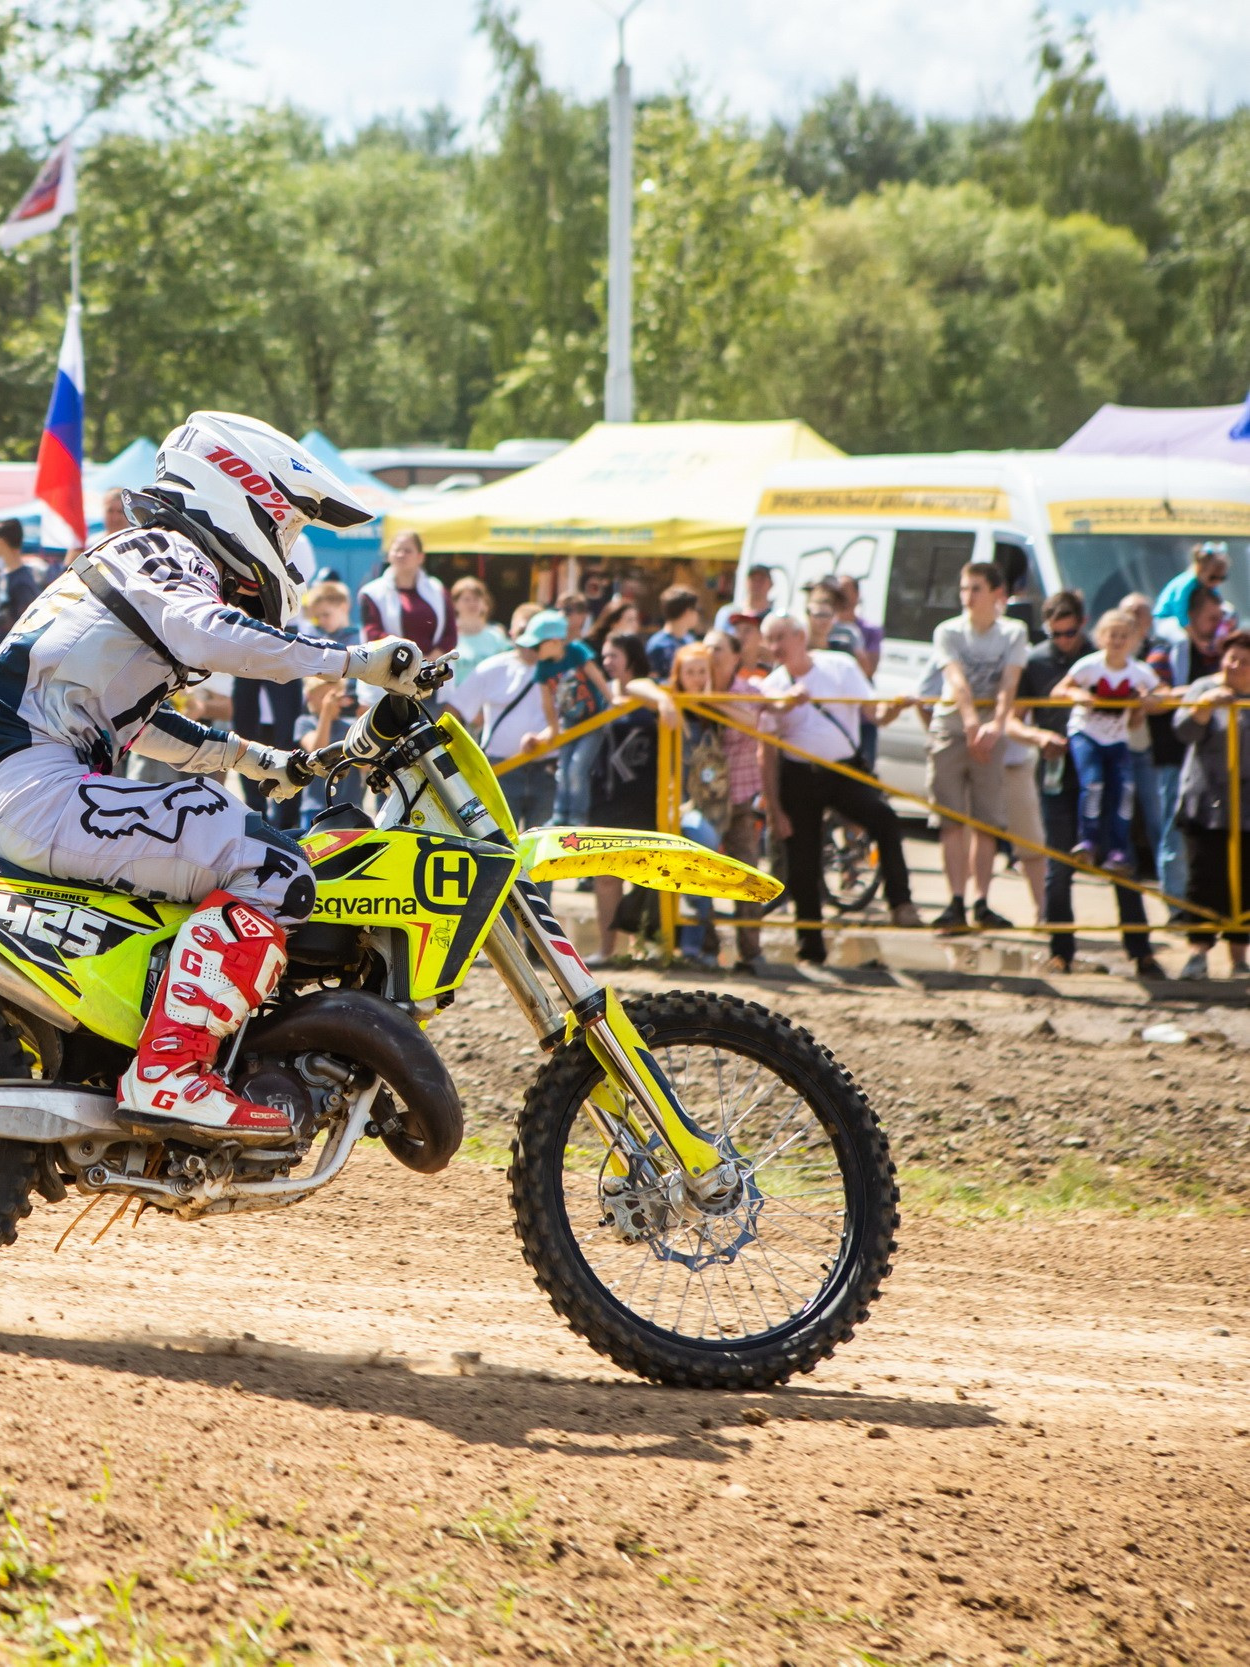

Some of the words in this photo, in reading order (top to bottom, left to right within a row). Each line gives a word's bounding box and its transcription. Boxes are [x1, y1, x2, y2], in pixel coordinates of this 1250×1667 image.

[203, 445, 292, 522] 100%
[433, 857, 469, 898] H
[25, 887, 90, 903] SHERSHNEV
[313, 897, 417, 918] sqvarna
[180, 948, 203, 978] G
[151, 1089, 178, 1110] G
